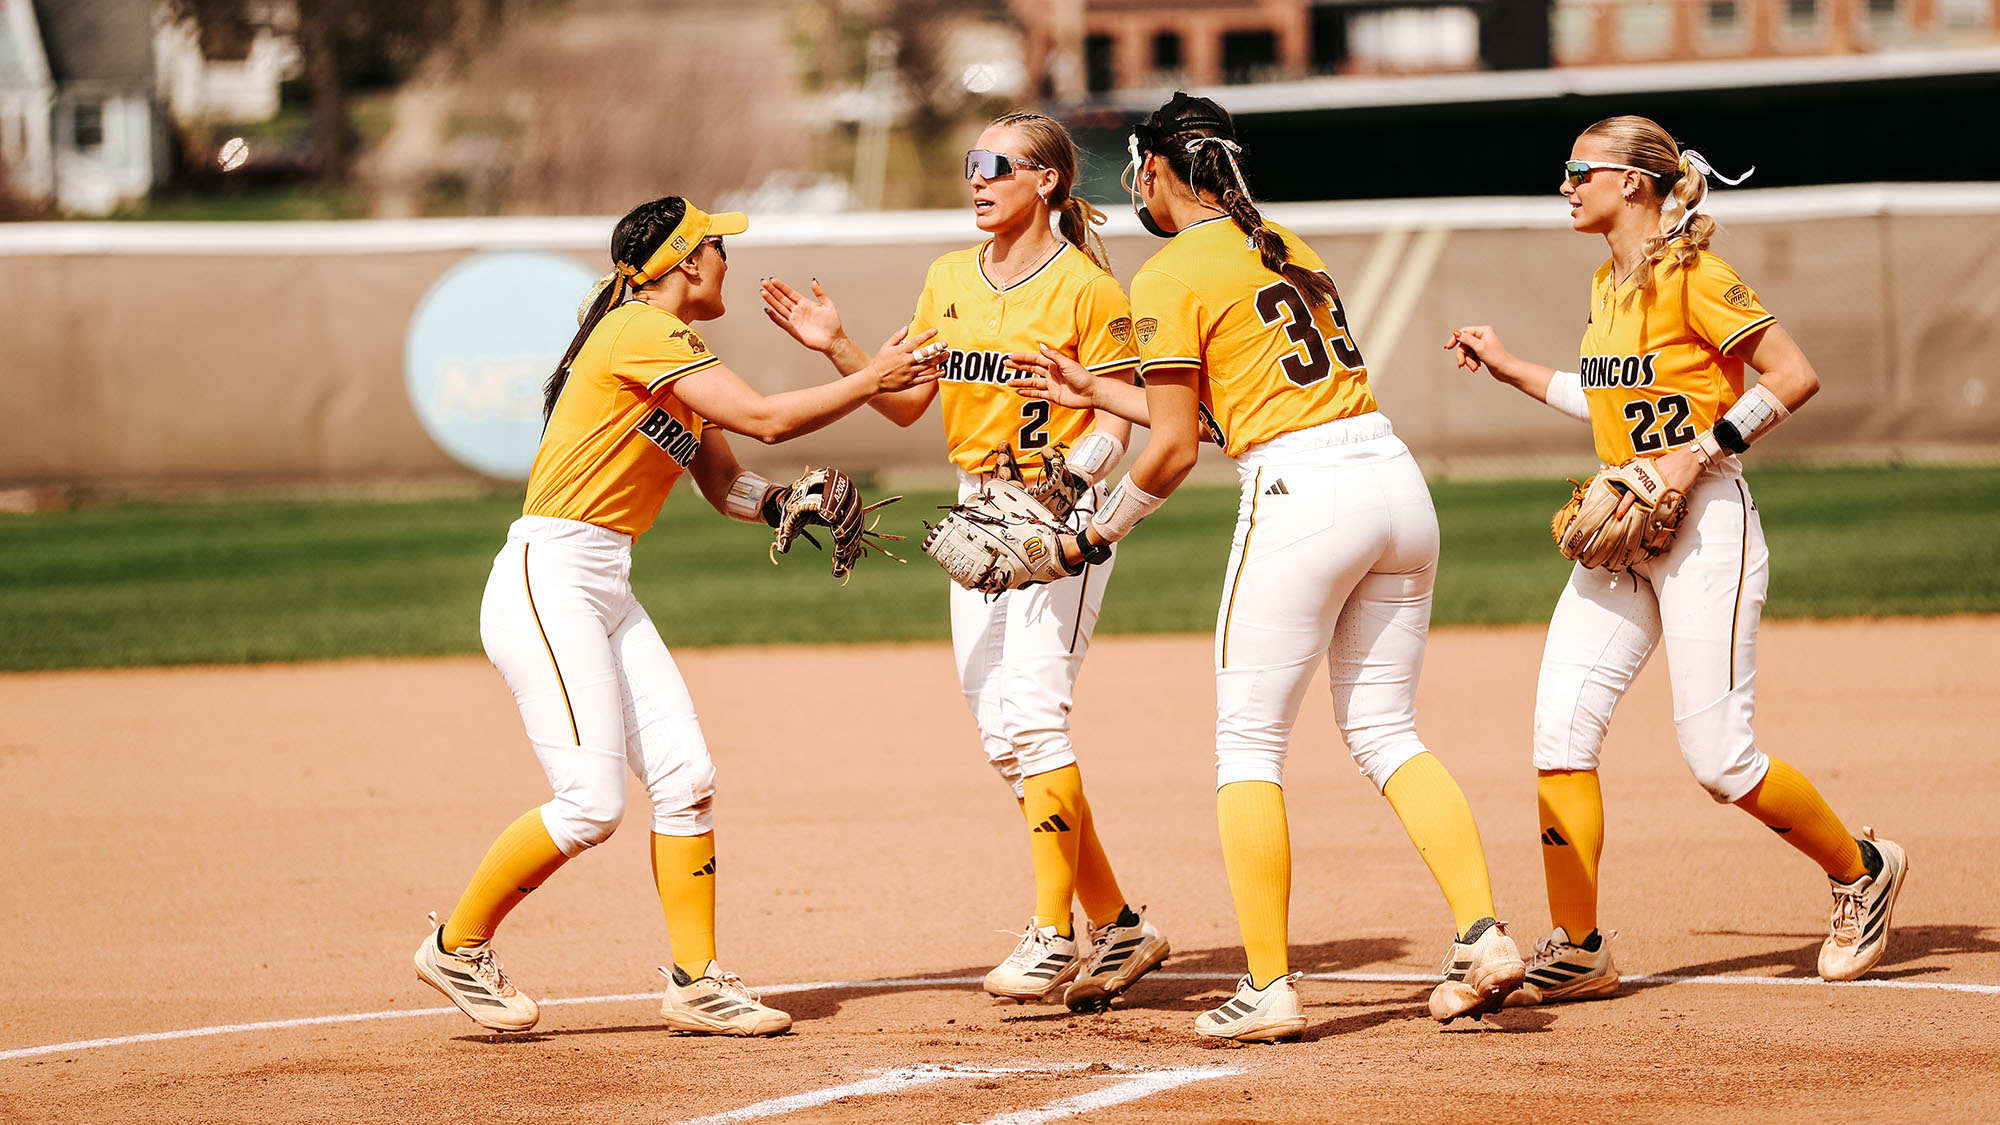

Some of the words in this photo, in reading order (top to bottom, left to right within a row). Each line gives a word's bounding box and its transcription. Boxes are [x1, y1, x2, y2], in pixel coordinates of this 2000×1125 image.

[1254, 269, 1366, 388] 33
[1018, 399, 1050, 451] 2
[1623, 394, 1698, 454] 22
[833, 476, 846, 502] A2000
[1633, 465, 1657, 494] Wilson
